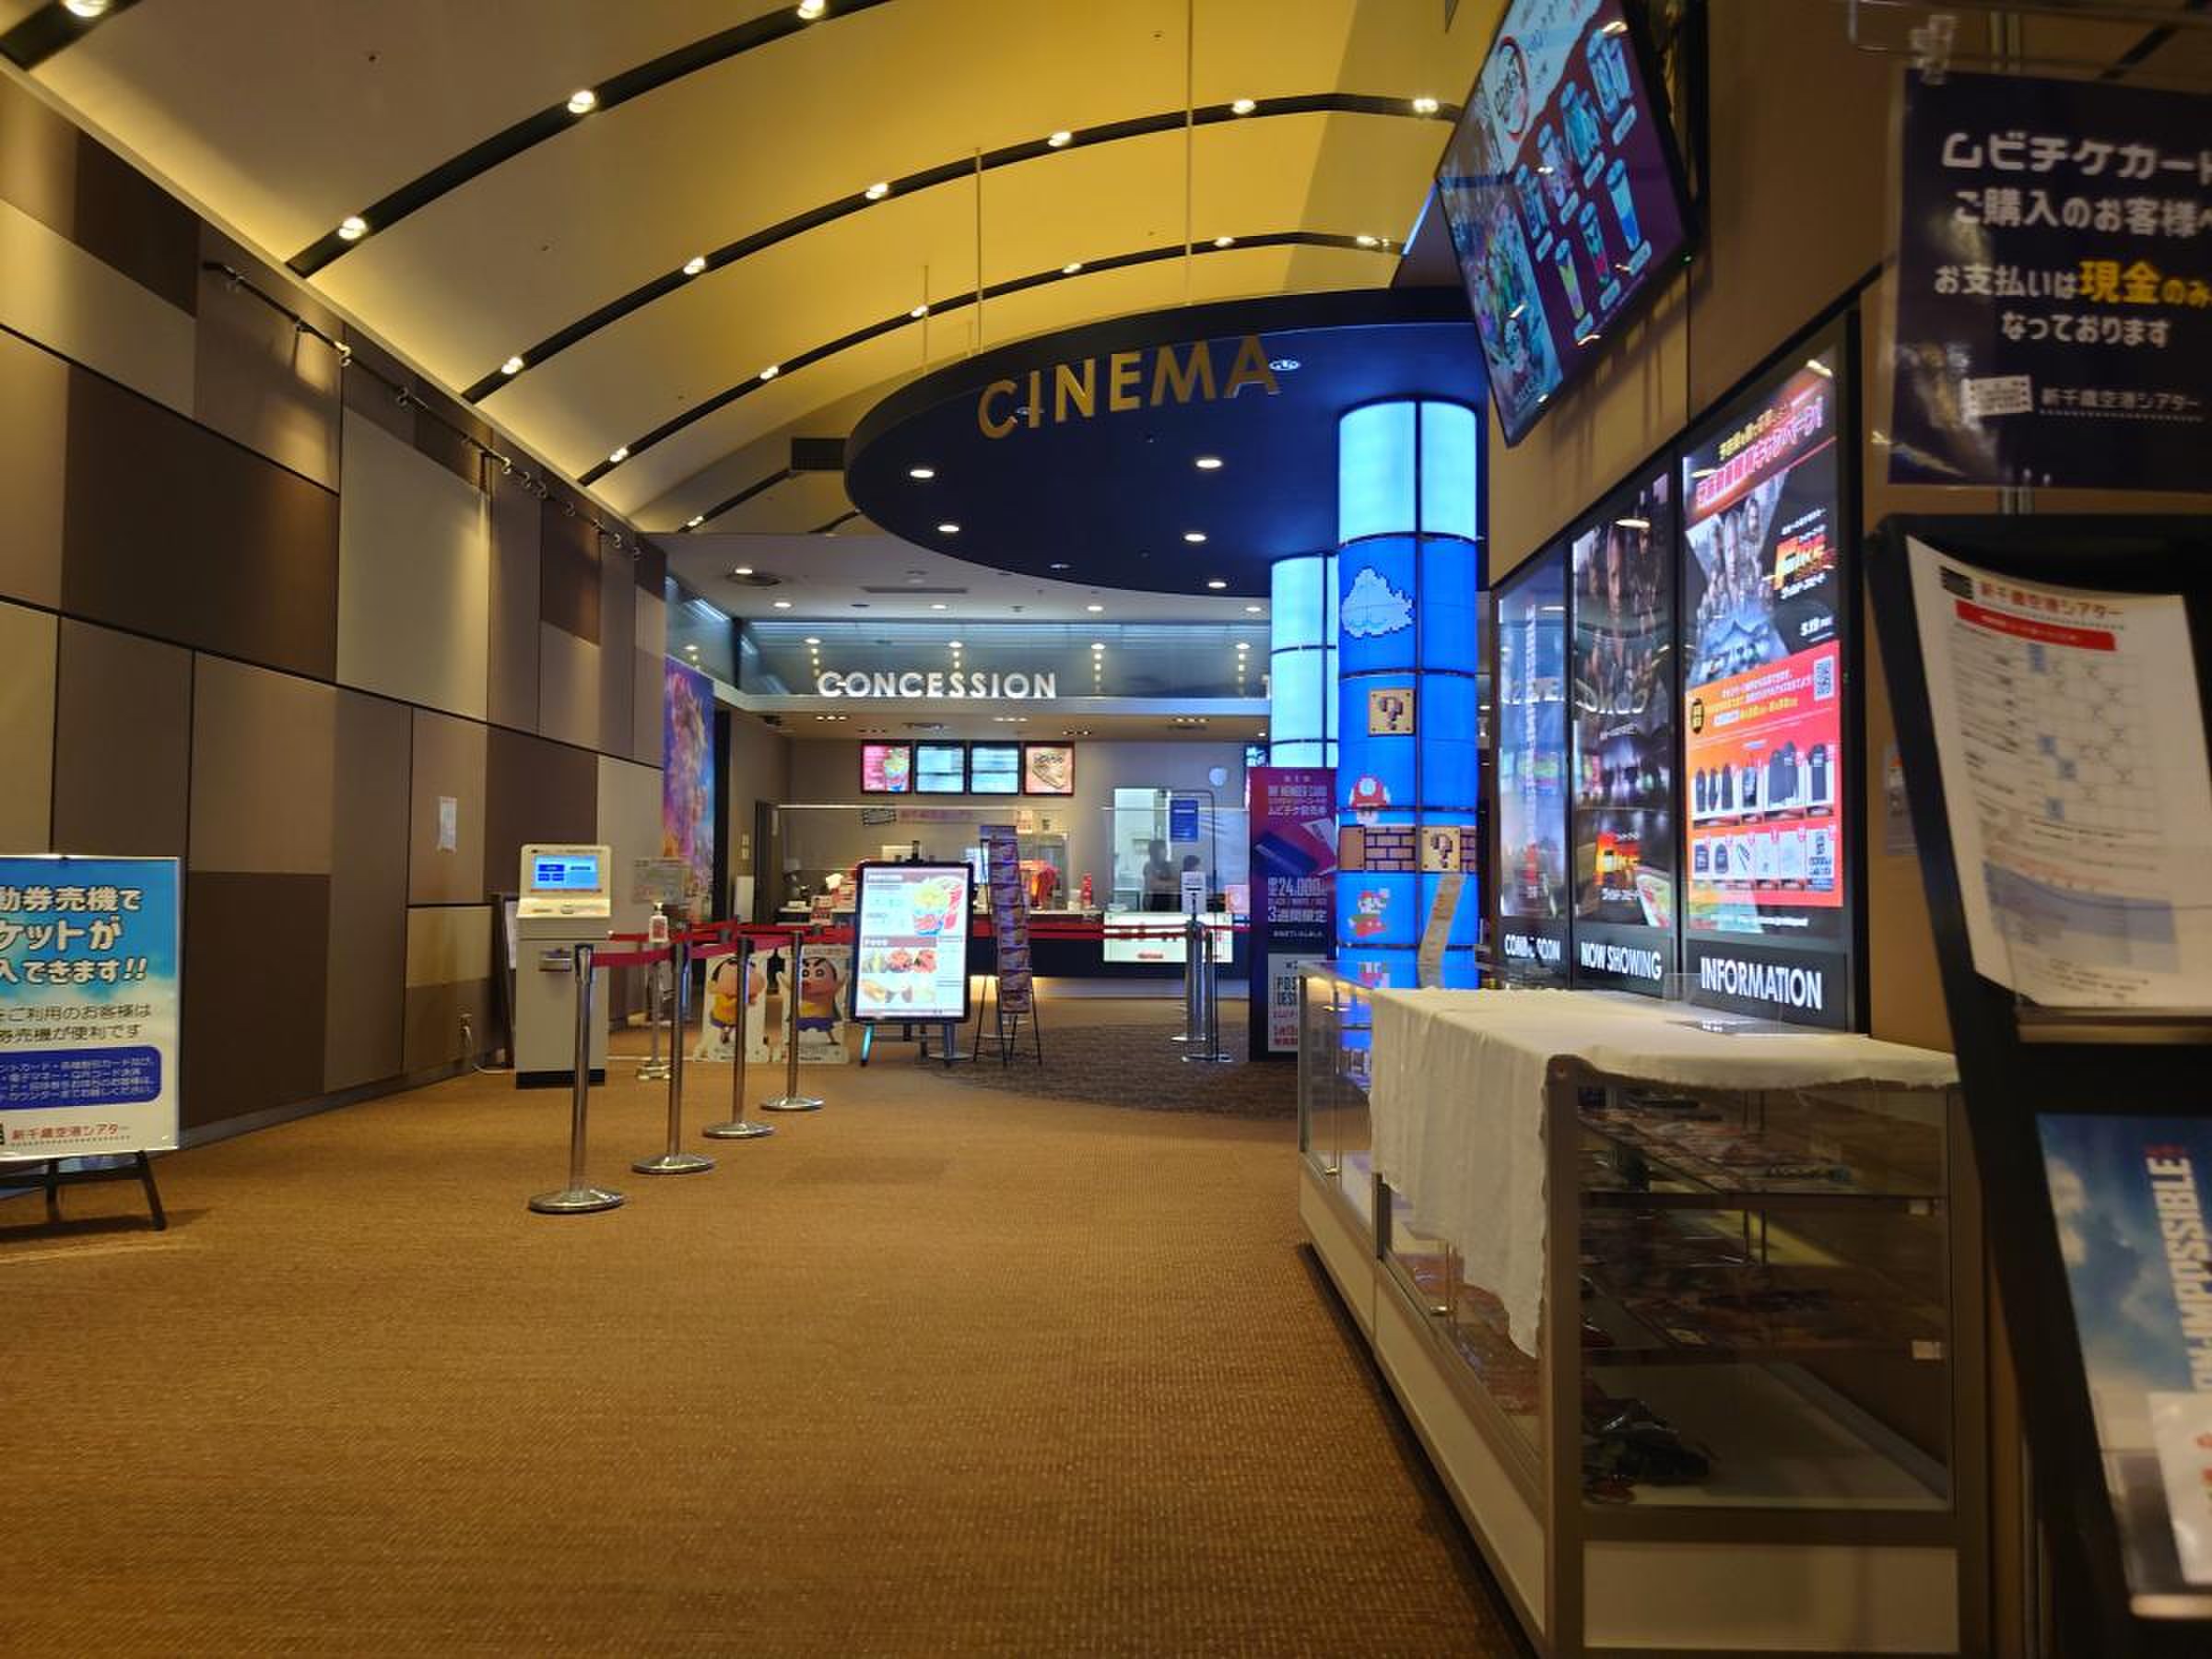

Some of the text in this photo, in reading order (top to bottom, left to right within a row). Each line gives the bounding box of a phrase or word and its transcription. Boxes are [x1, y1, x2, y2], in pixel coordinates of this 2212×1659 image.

[2002, 312, 2172, 348] なっております
[978, 334, 1280, 439] CINEMA
[817, 670, 1057, 699] CONCESSION
[1581, 941, 1663, 981] NOW SHOWING
[1700, 956, 1822, 1010] INFORMATION
